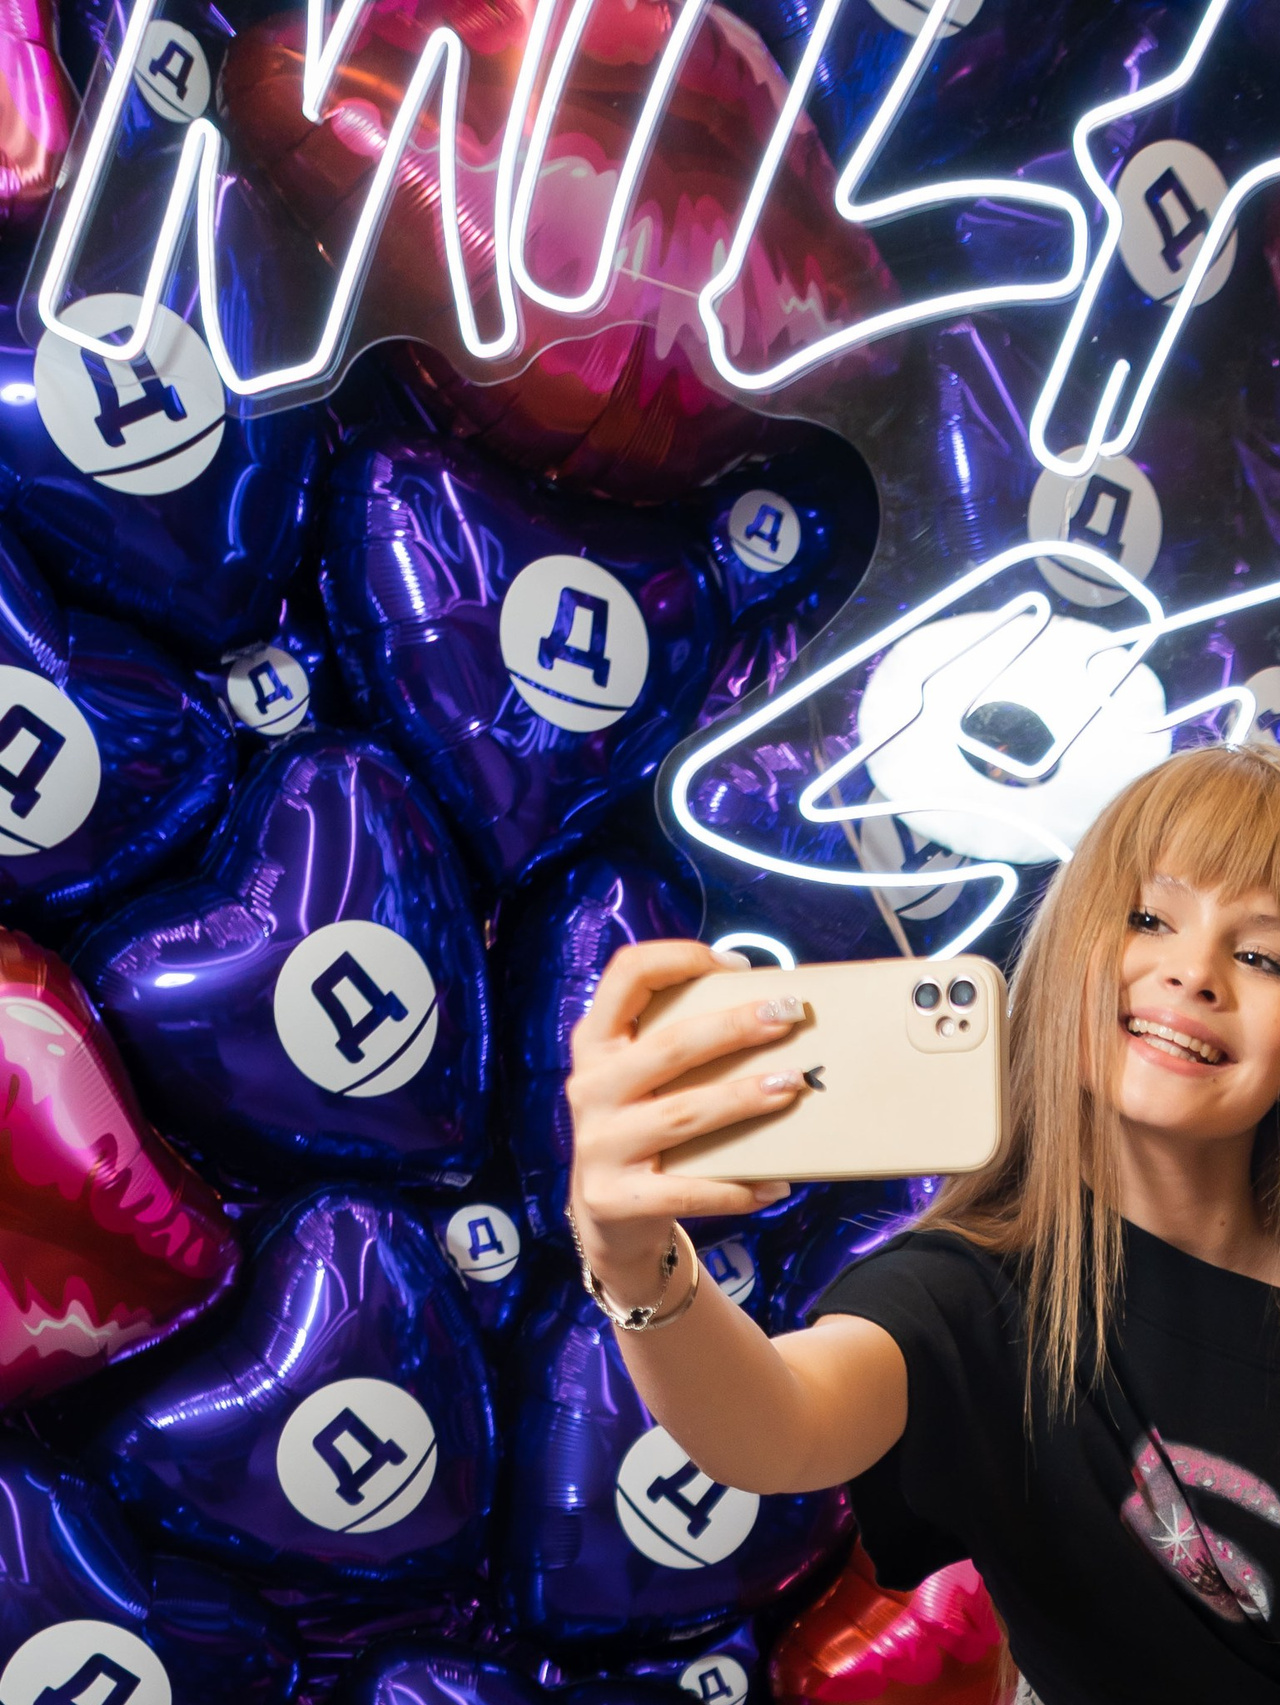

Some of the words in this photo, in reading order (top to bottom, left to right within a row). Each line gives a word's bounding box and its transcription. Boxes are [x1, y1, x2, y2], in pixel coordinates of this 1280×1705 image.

[151, 39, 193, 99] Д
[1145, 167, 1210, 274] Д
[79, 323, 186, 447] Д
[745, 503, 782, 552] Д
[1071, 472, 1130, 561] Д
[538, 586, 610, 688] Д
[252, 665, 290, 716] Д
[0, 705, 66, 819] Д
[311, 952, 408, 1064] Д
[469, 1216, 504, 1261] Д
[314, 1407, 407, 1506] Д
[699, 1667, 732, 1703] Д
